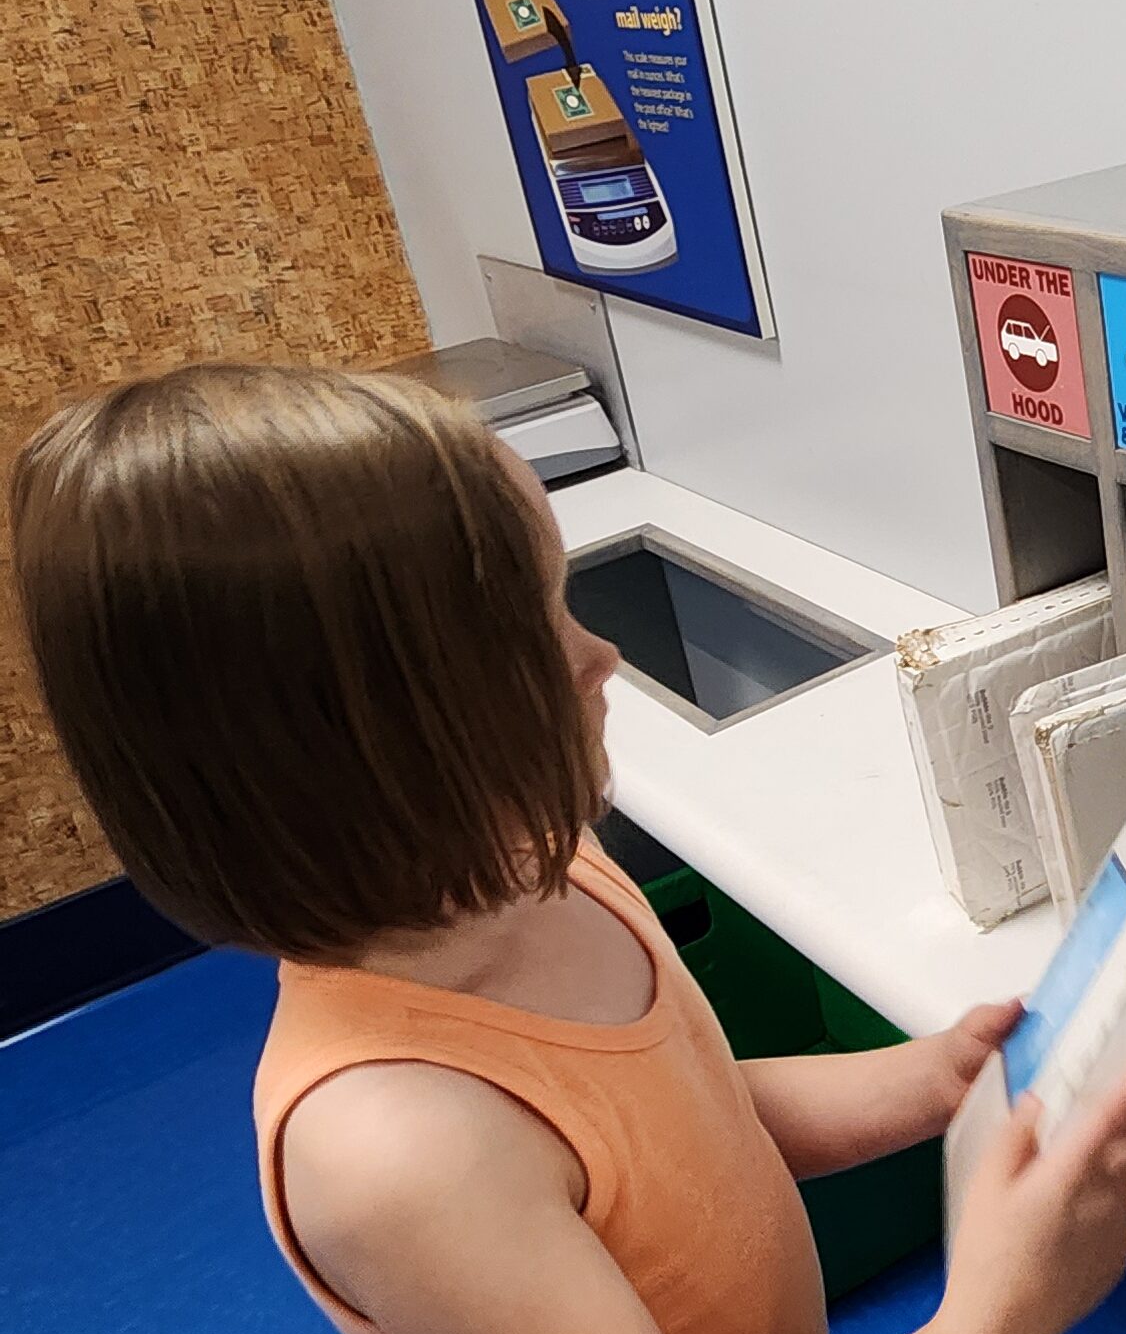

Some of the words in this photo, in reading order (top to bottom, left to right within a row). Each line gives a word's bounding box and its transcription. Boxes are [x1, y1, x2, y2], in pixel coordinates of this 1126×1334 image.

[615, 5, 640, 28] mail
[640, 5, 682, 36] weigh?
[972, 257, 1032, 292] UNDER
[1033, 268, 1071, 297] THE
[1011, 392, 1064, 426] HOOD
